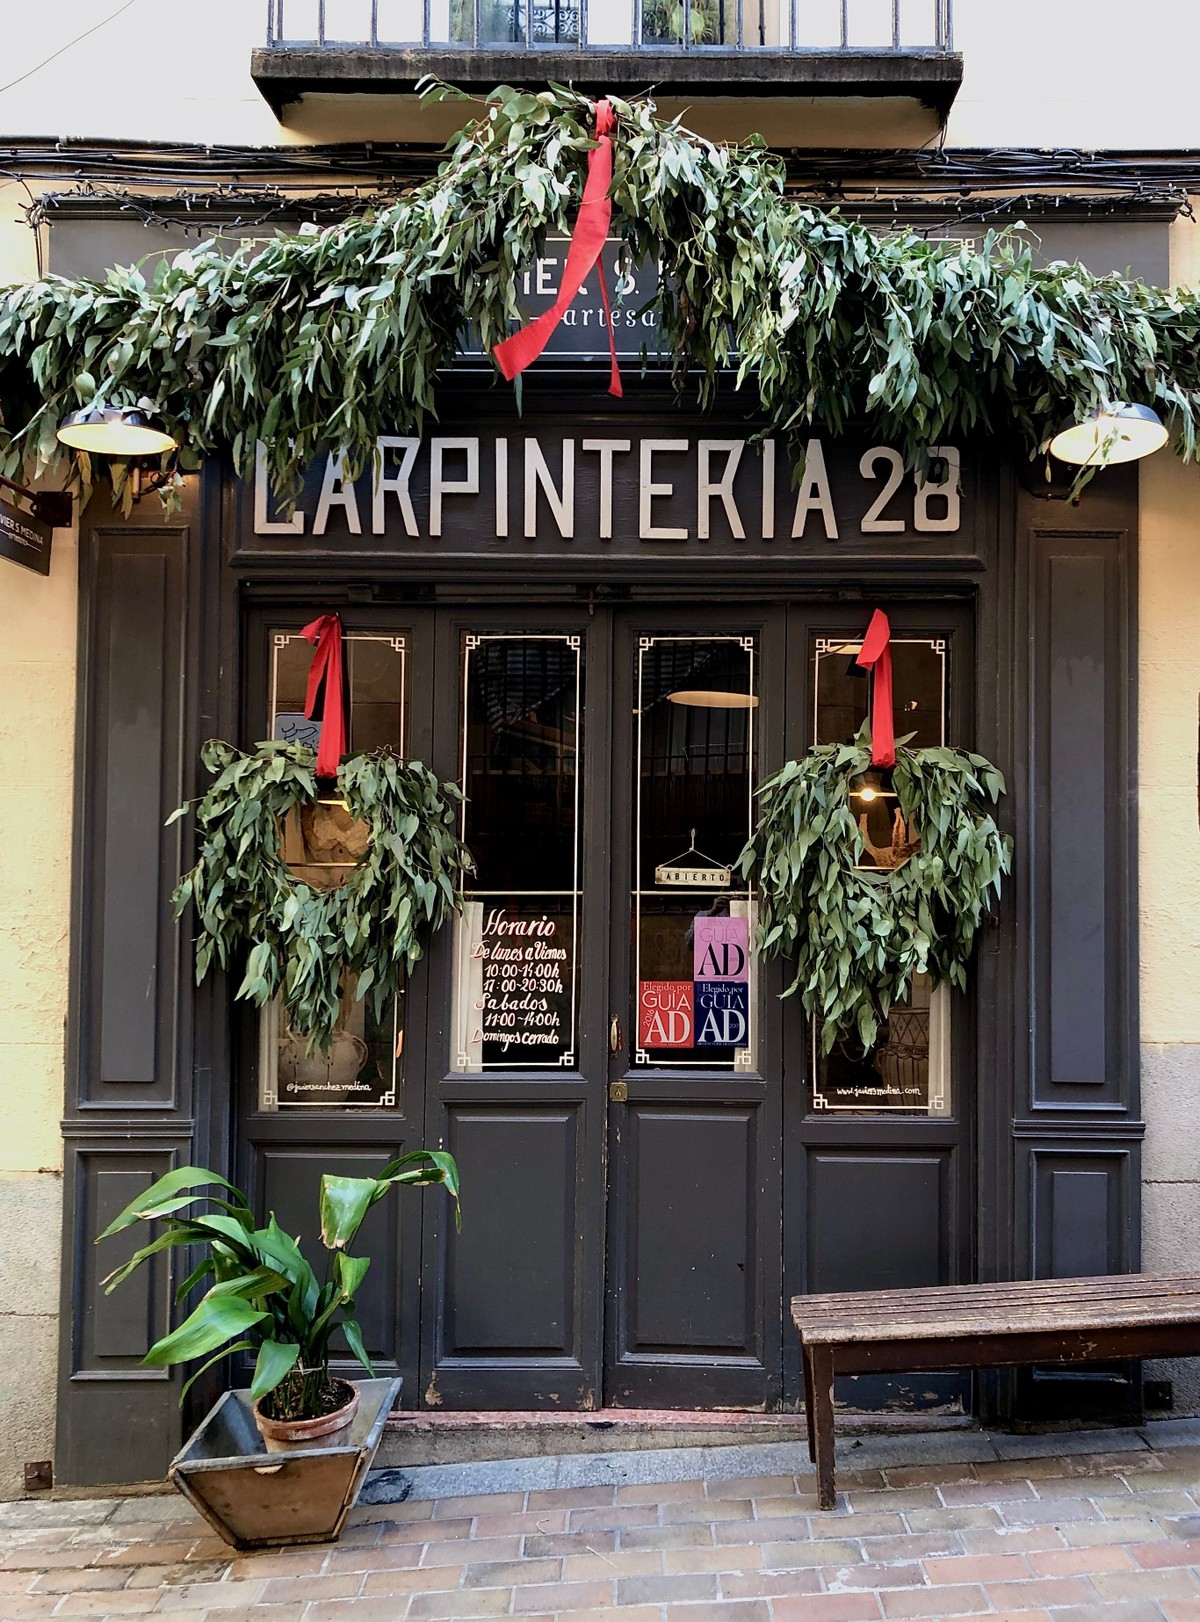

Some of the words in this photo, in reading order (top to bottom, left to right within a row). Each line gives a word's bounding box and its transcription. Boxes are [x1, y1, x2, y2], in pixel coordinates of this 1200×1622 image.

[563, 308, 661, 328] artesa
[253, 436, 839, 540] CARPINTERIA
[859, 446, 961, 532] 28
[666, 872, 725, 882] ABIERTO
[480, 909, 556, 937] Horario
[470, 940, 490, 959] De
[491, 941, 523, 961] lunes
[525, 947, 534, 960] a
[697, 943, 745, 977] AD
[643, 982, 674, 994] Elegido
[676, 984, 691, 994] por
[702, 983, 729, 994] Elegido
[730, 986, 744, 995] por
[474, 993, 548, 1011] Sabados
[641, 990, 691, 1011] GUÍA
[643, 1009, 655, 1027] 2016
[644, 1010, 690, 1043] AD
[697, 1008, 745, 1043] AD
[469, 1026, 521, 1051] Domingos
